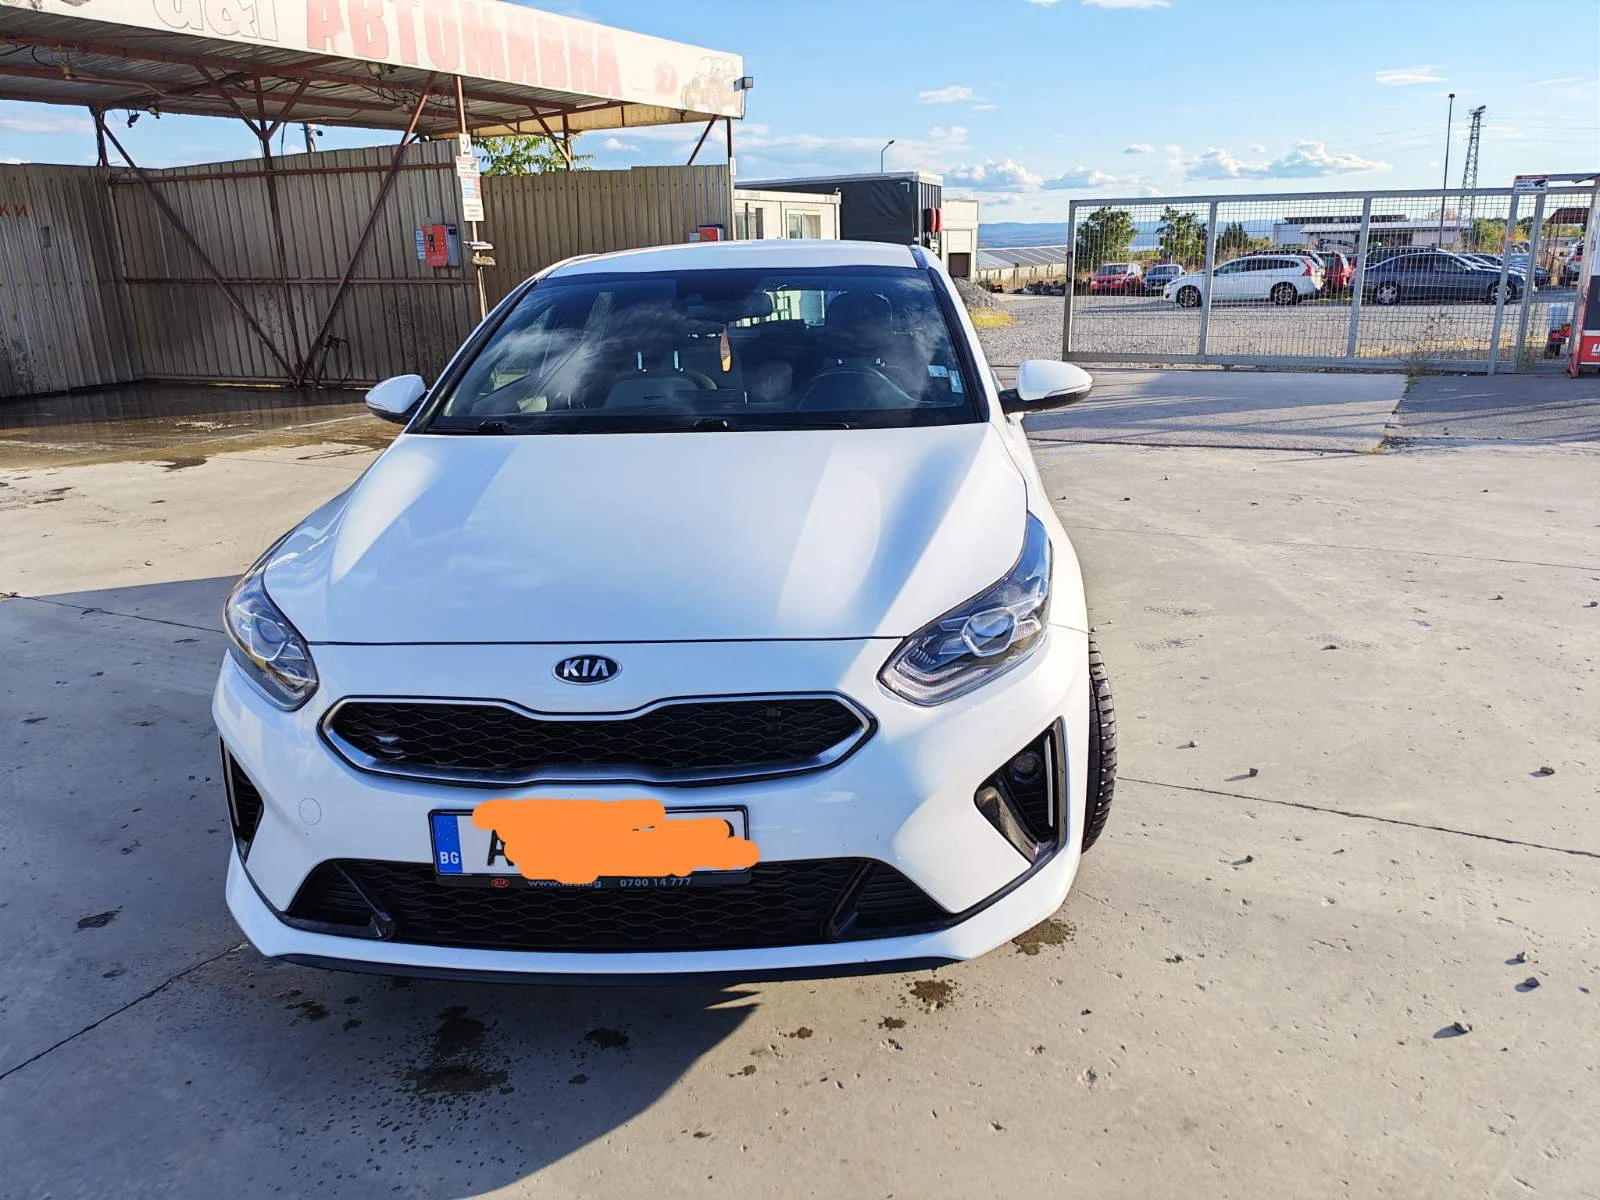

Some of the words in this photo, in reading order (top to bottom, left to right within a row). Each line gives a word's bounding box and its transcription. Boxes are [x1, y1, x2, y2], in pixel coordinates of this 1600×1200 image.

[306, 0, 622, 98] АВТОМИВКА
[563, 659, 609, 677] KIA
[440, 851, 459, 865] BG
[620, 879, 649, 888] 0700
[654, 878, 667, 887] 14
[670, 877, 692, 886] 777
